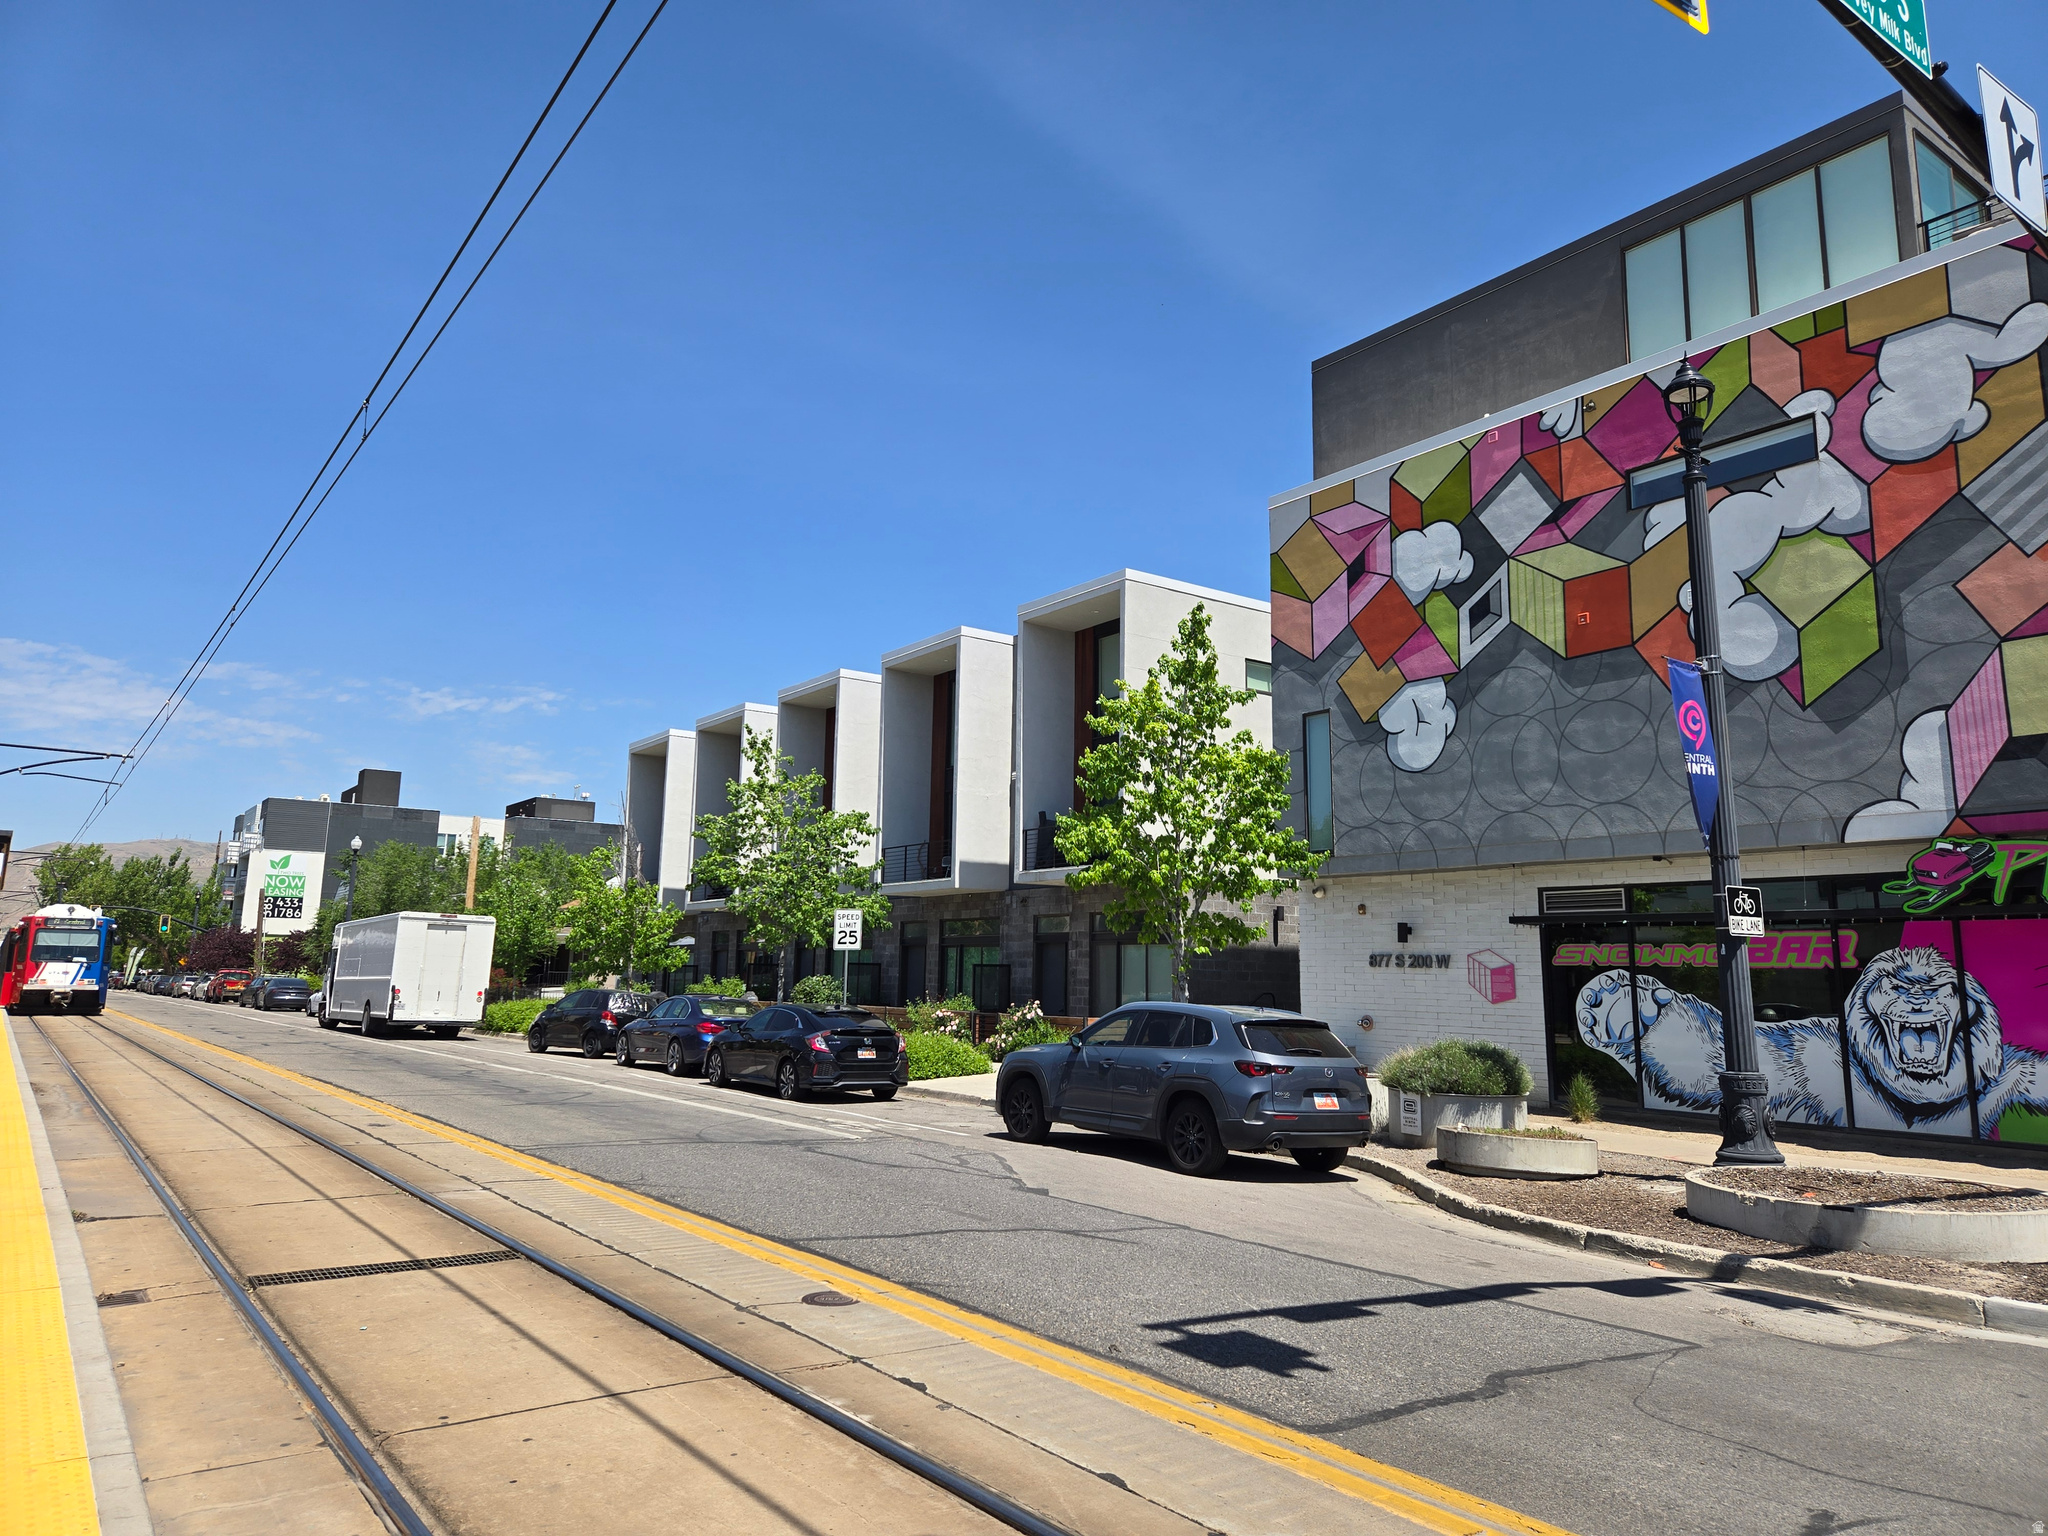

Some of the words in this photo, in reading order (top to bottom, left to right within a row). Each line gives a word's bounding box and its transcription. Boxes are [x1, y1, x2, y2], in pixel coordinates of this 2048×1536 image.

[1879, 7, 1901, 43] Milk
[1903, 29, 1928, 67] Blvd
[1684, 752, 1714, 764] ENTRAL
[265, 875, 305, 888] NOW
[265, 887, 304, 897] LEASING
[274, 908, 301, 918] 1786
[1731, 918, 1745, 931] BIKE
[1746, 919, 1762, 932] LANE
[837, 930, 858, 945] 25
[1368, 953, 1393, 968] 877
[1395, 954, 1406, 968] S
[1408, 954, 1433, 968] 200
[1435, 954, 1452, 969] W
